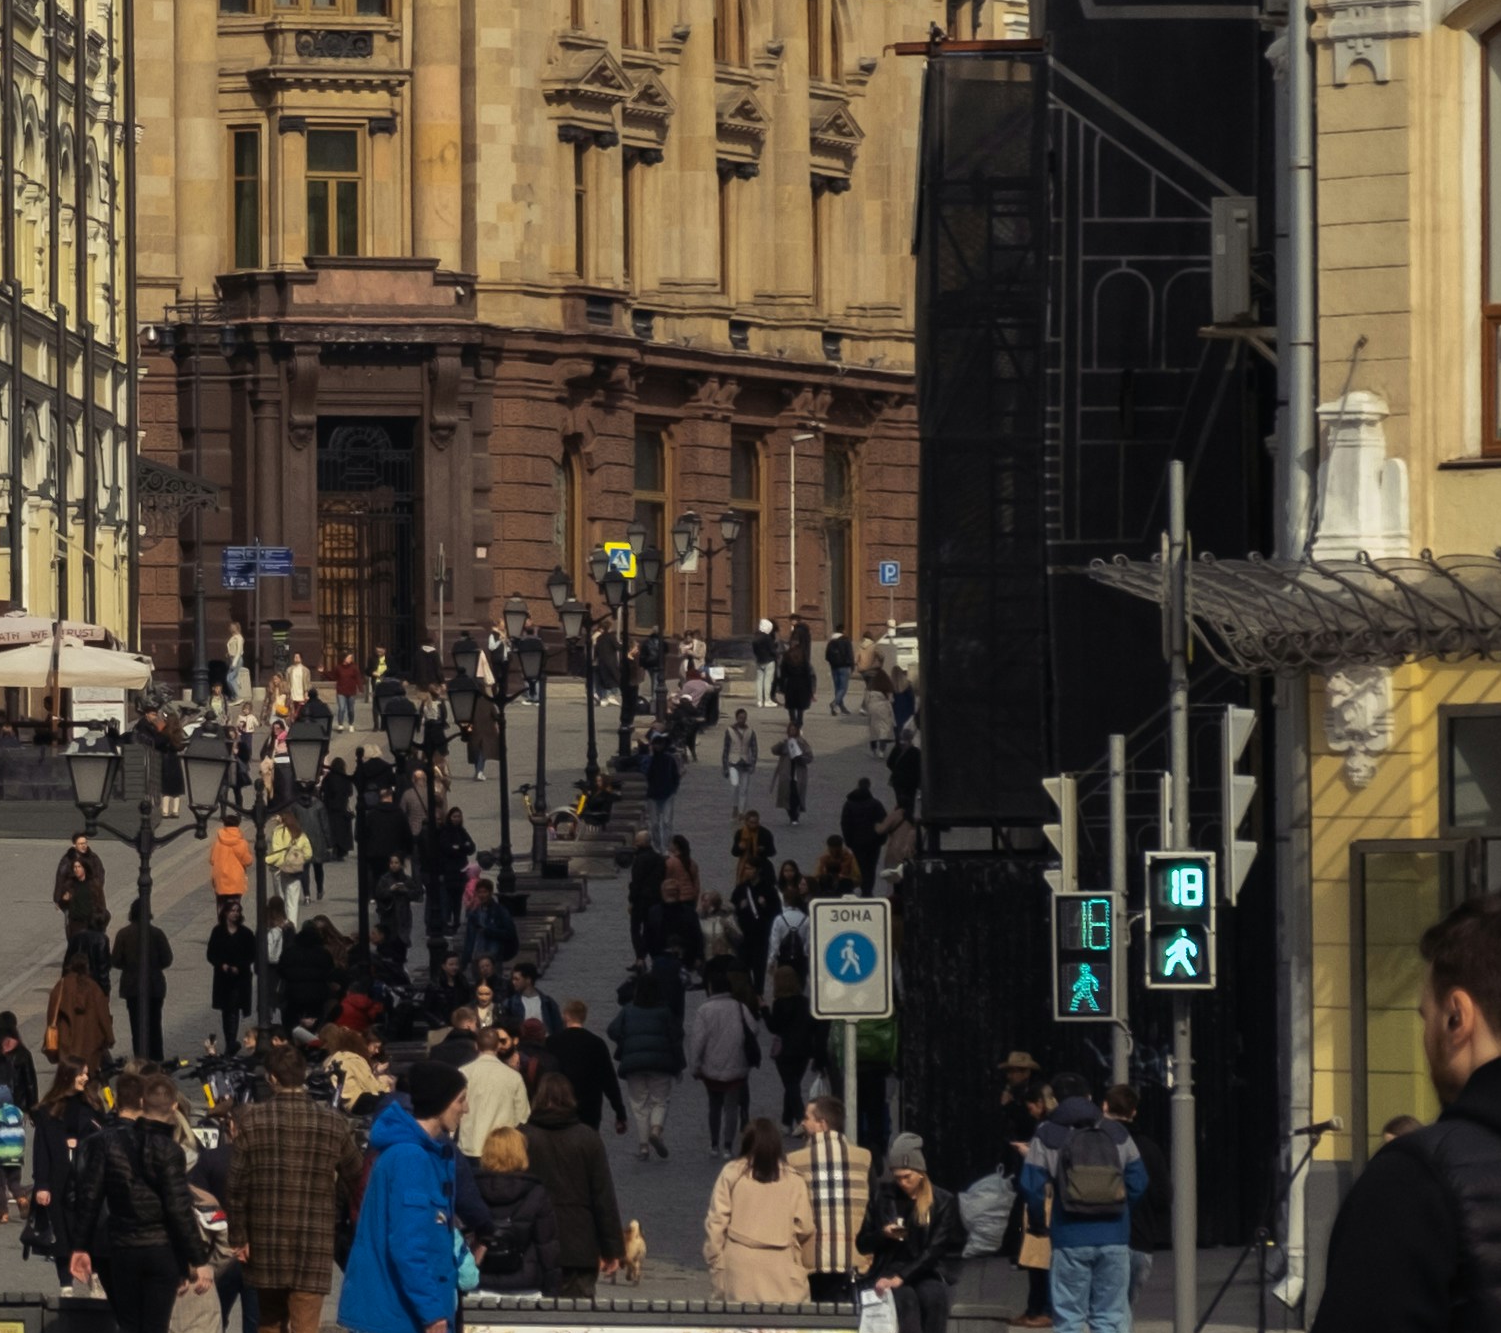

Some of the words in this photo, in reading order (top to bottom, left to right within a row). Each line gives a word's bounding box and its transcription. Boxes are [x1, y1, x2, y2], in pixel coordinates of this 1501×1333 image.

[31, 630, 48, 639] WE
[1171, 867, 1204, 906] 18
[830, 909, 873, 923] ЗОНА
[1081, 899, 1110, 951] 18
